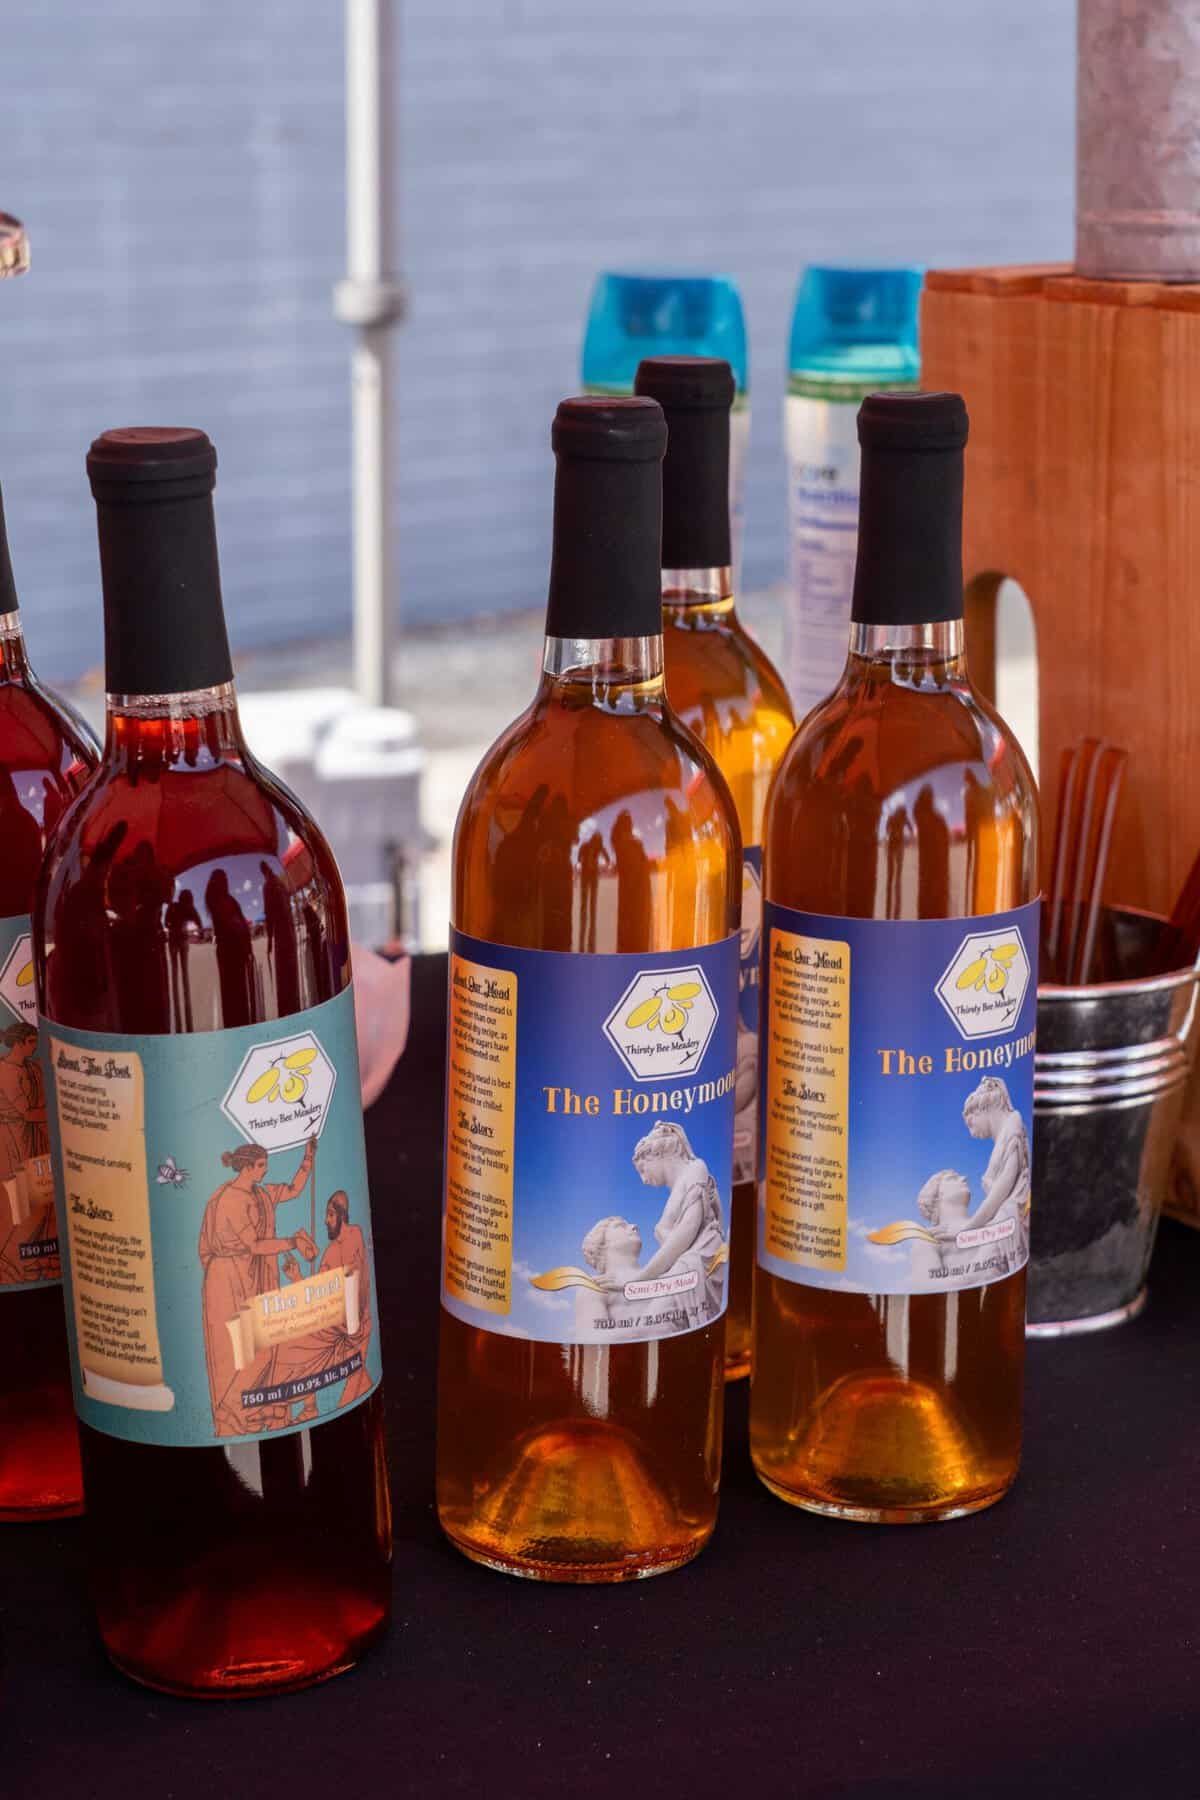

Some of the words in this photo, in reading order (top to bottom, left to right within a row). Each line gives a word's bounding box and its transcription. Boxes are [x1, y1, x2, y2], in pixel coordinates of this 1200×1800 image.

[955, 1003, 981, 1017] Thirsty
[982, 1002, 995, 1013] Bee
[625, 1044, 655, 1056] Thirsty
[656, 1043, 670, 1053] Bee
[671, 1039, 701, 1051] Meadery
[876, 1049, 933, 1076] The
[542, 1087, 600, 1115] The
[248, 1115, 278, 1131] Thirsty
[279, 1113, 293, 1124] Bee
[294, 1103, 322, 1119] Meadery
[242, 1392, 265, 1405] 750
[267, 1389, 282, 1401] ml
